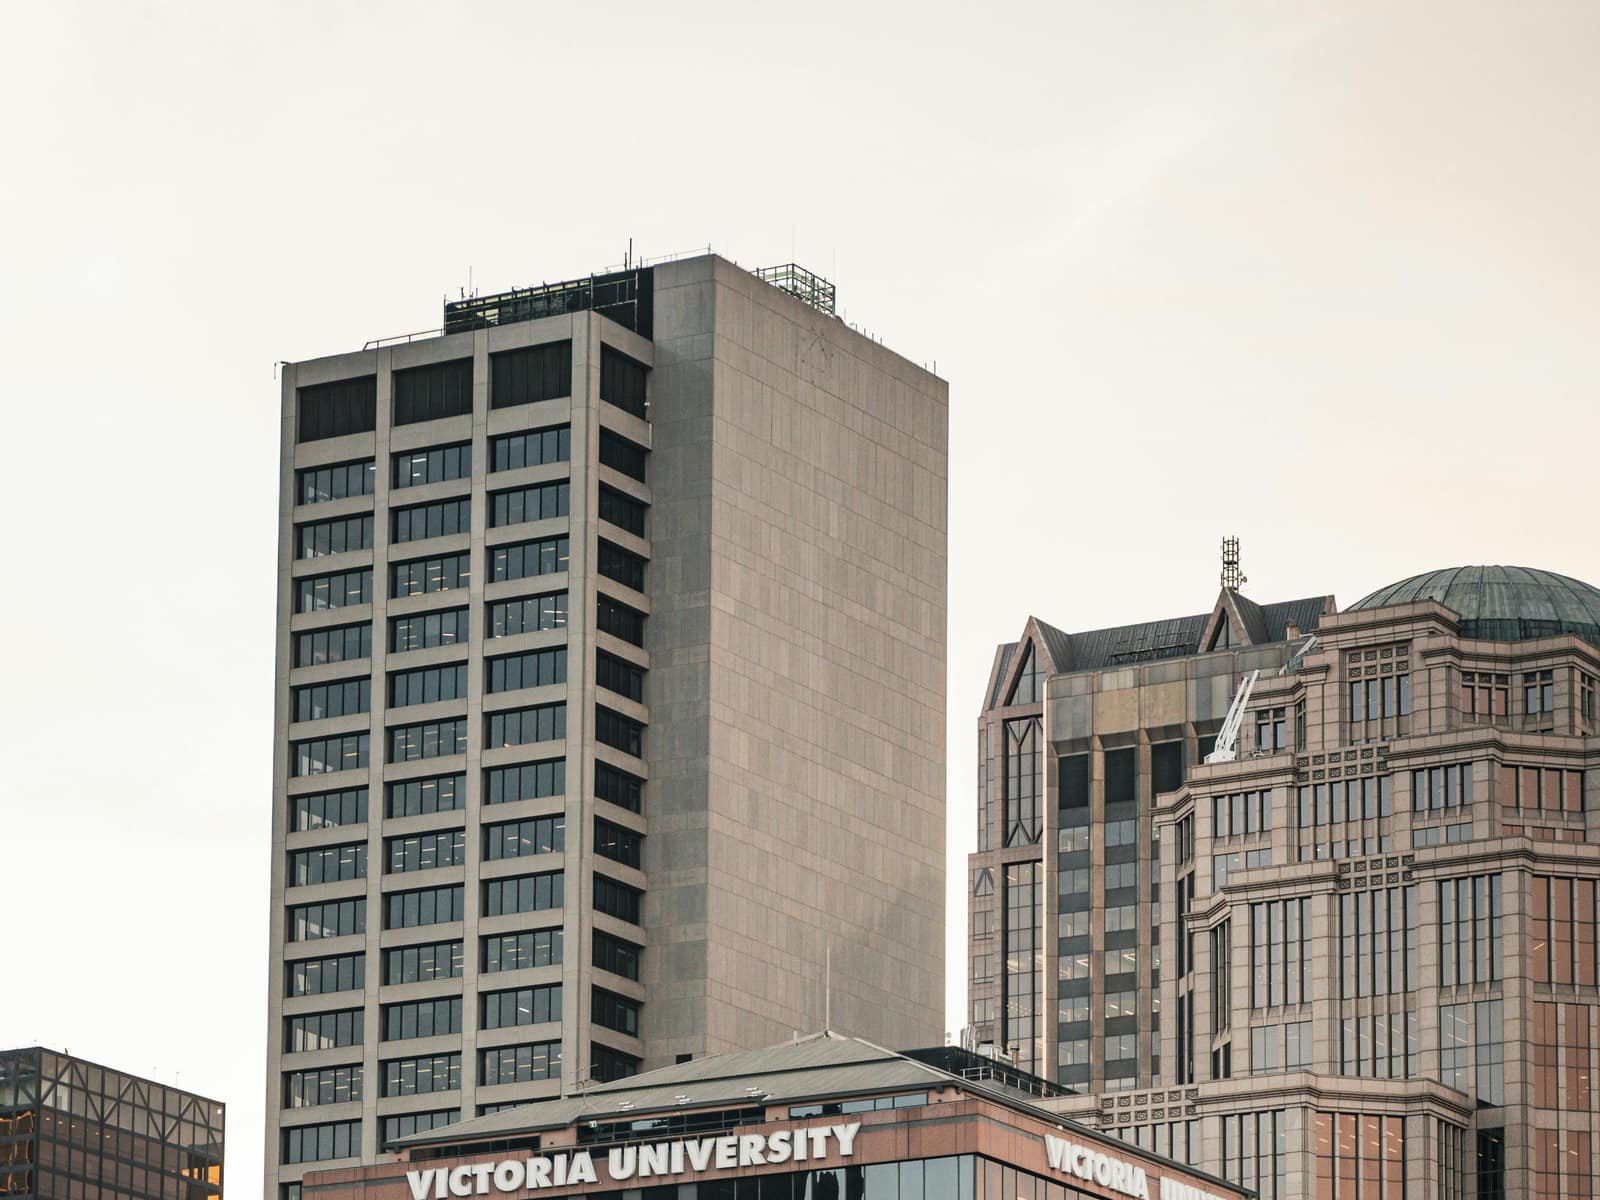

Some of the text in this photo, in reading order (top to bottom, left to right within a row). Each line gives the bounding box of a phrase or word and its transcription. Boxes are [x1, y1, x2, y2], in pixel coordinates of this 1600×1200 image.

[406, 1122, 861, 1200] VICTORIA UNIVERSITY
[1044, 1133, 1149, 1200] VICTORIA
